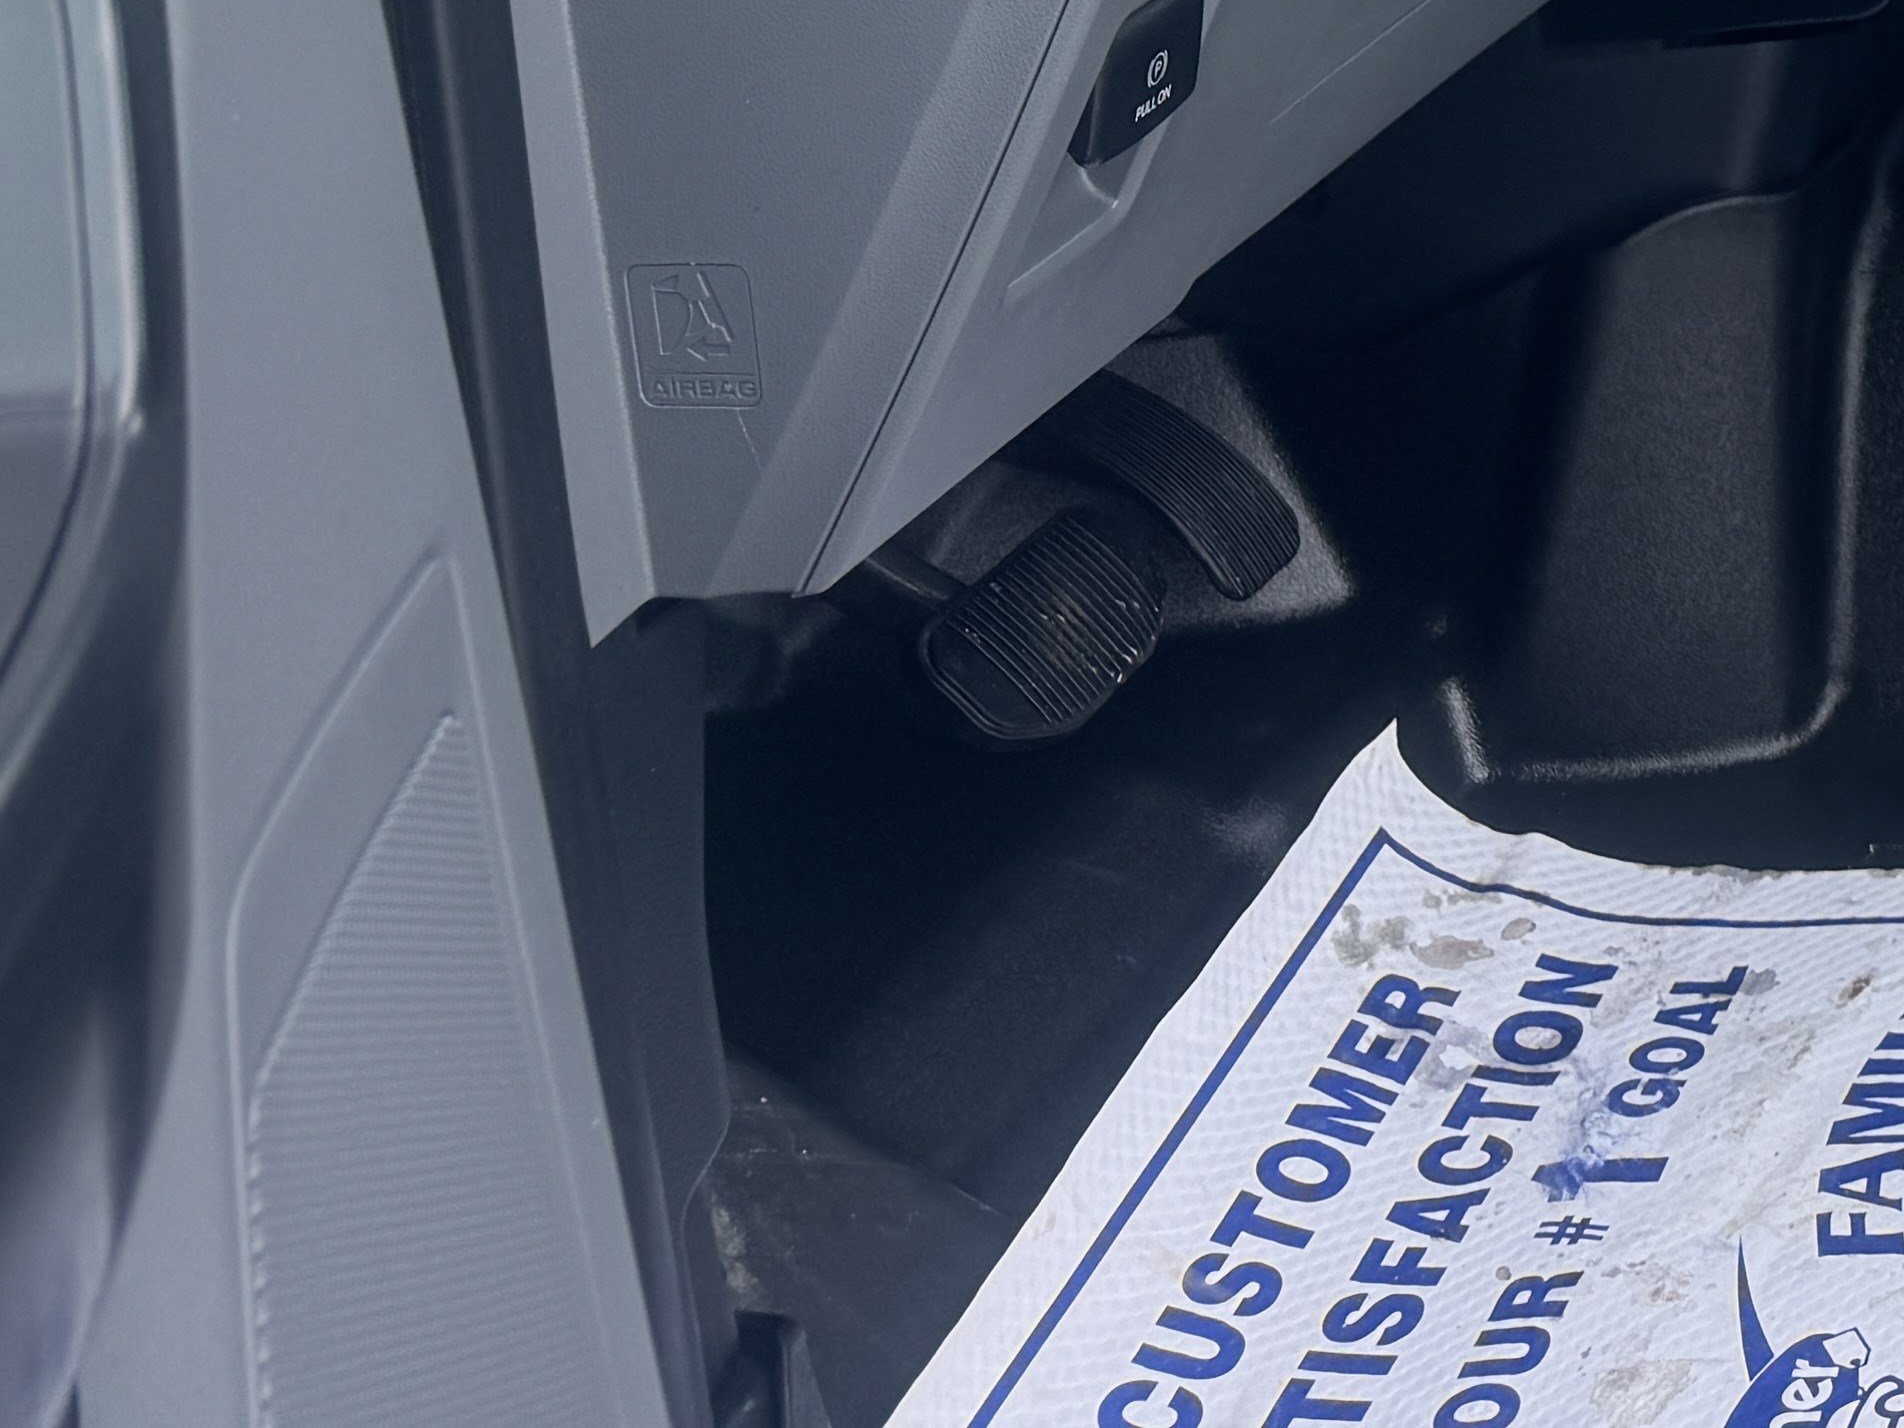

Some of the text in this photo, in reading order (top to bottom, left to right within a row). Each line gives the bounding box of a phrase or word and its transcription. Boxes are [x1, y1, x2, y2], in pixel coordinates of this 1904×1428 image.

[1134, 84, 1172, 123] PULL ON
[651, 377, 758, 400] AIRBAG
[1606, 964, 1750, 1119] GOAL
[1097, 973, 1464, 1428] CUSTOMER
